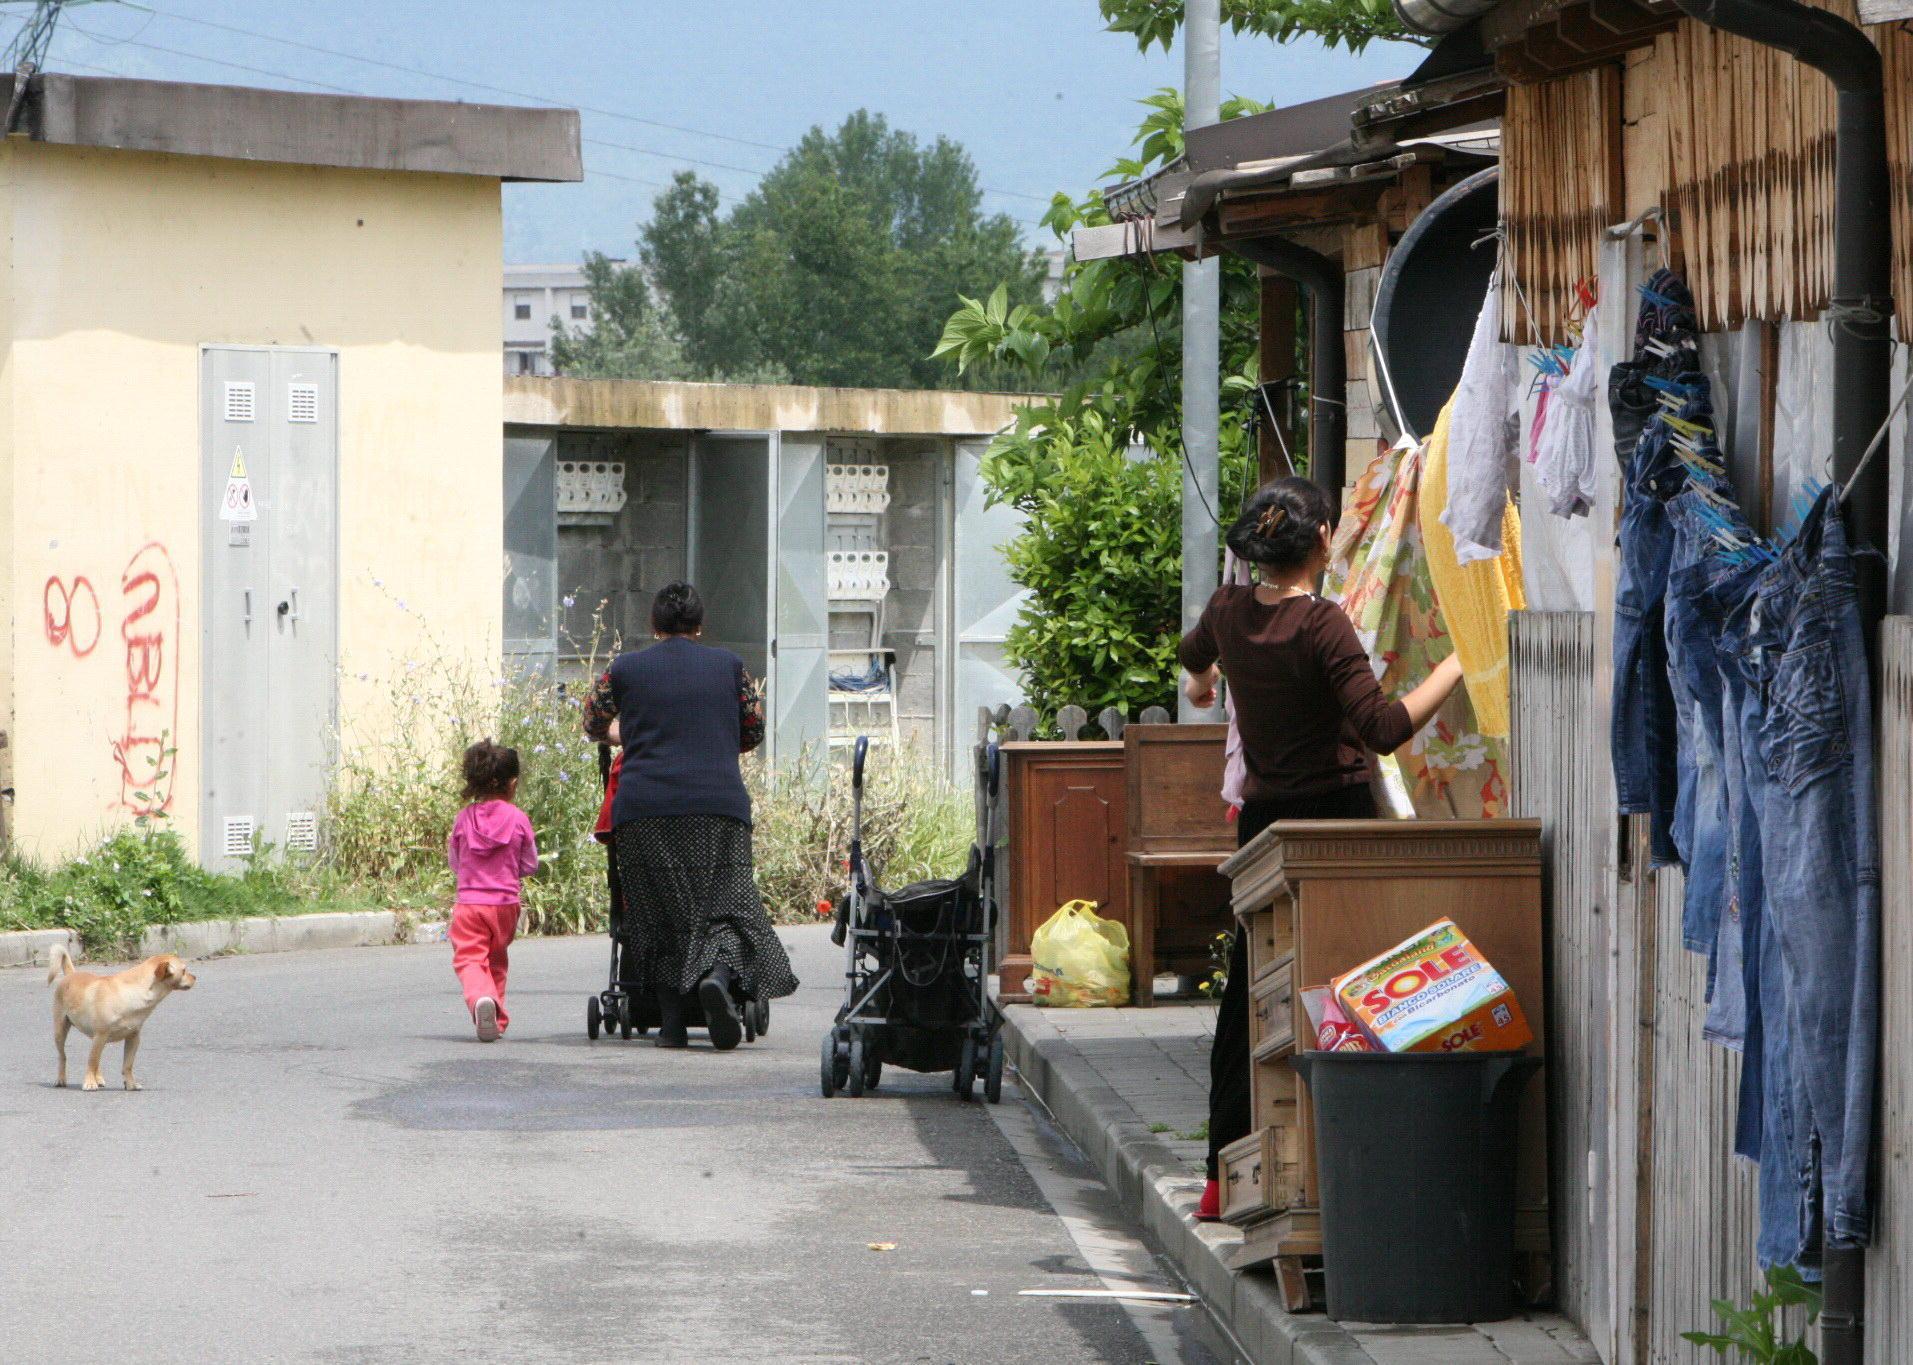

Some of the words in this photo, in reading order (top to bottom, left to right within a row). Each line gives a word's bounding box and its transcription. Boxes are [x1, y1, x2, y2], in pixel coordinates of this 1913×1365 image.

[1363, 945, 1471, 1015] SOLE
[1376, 991, 1428, 1026] BIANCO
[1427, 962, 1482, 995] SOLARE
[1407, 975, 1476, 1014] Bicarbonato
[1441, 1023, 1482, 1052] SOLE
